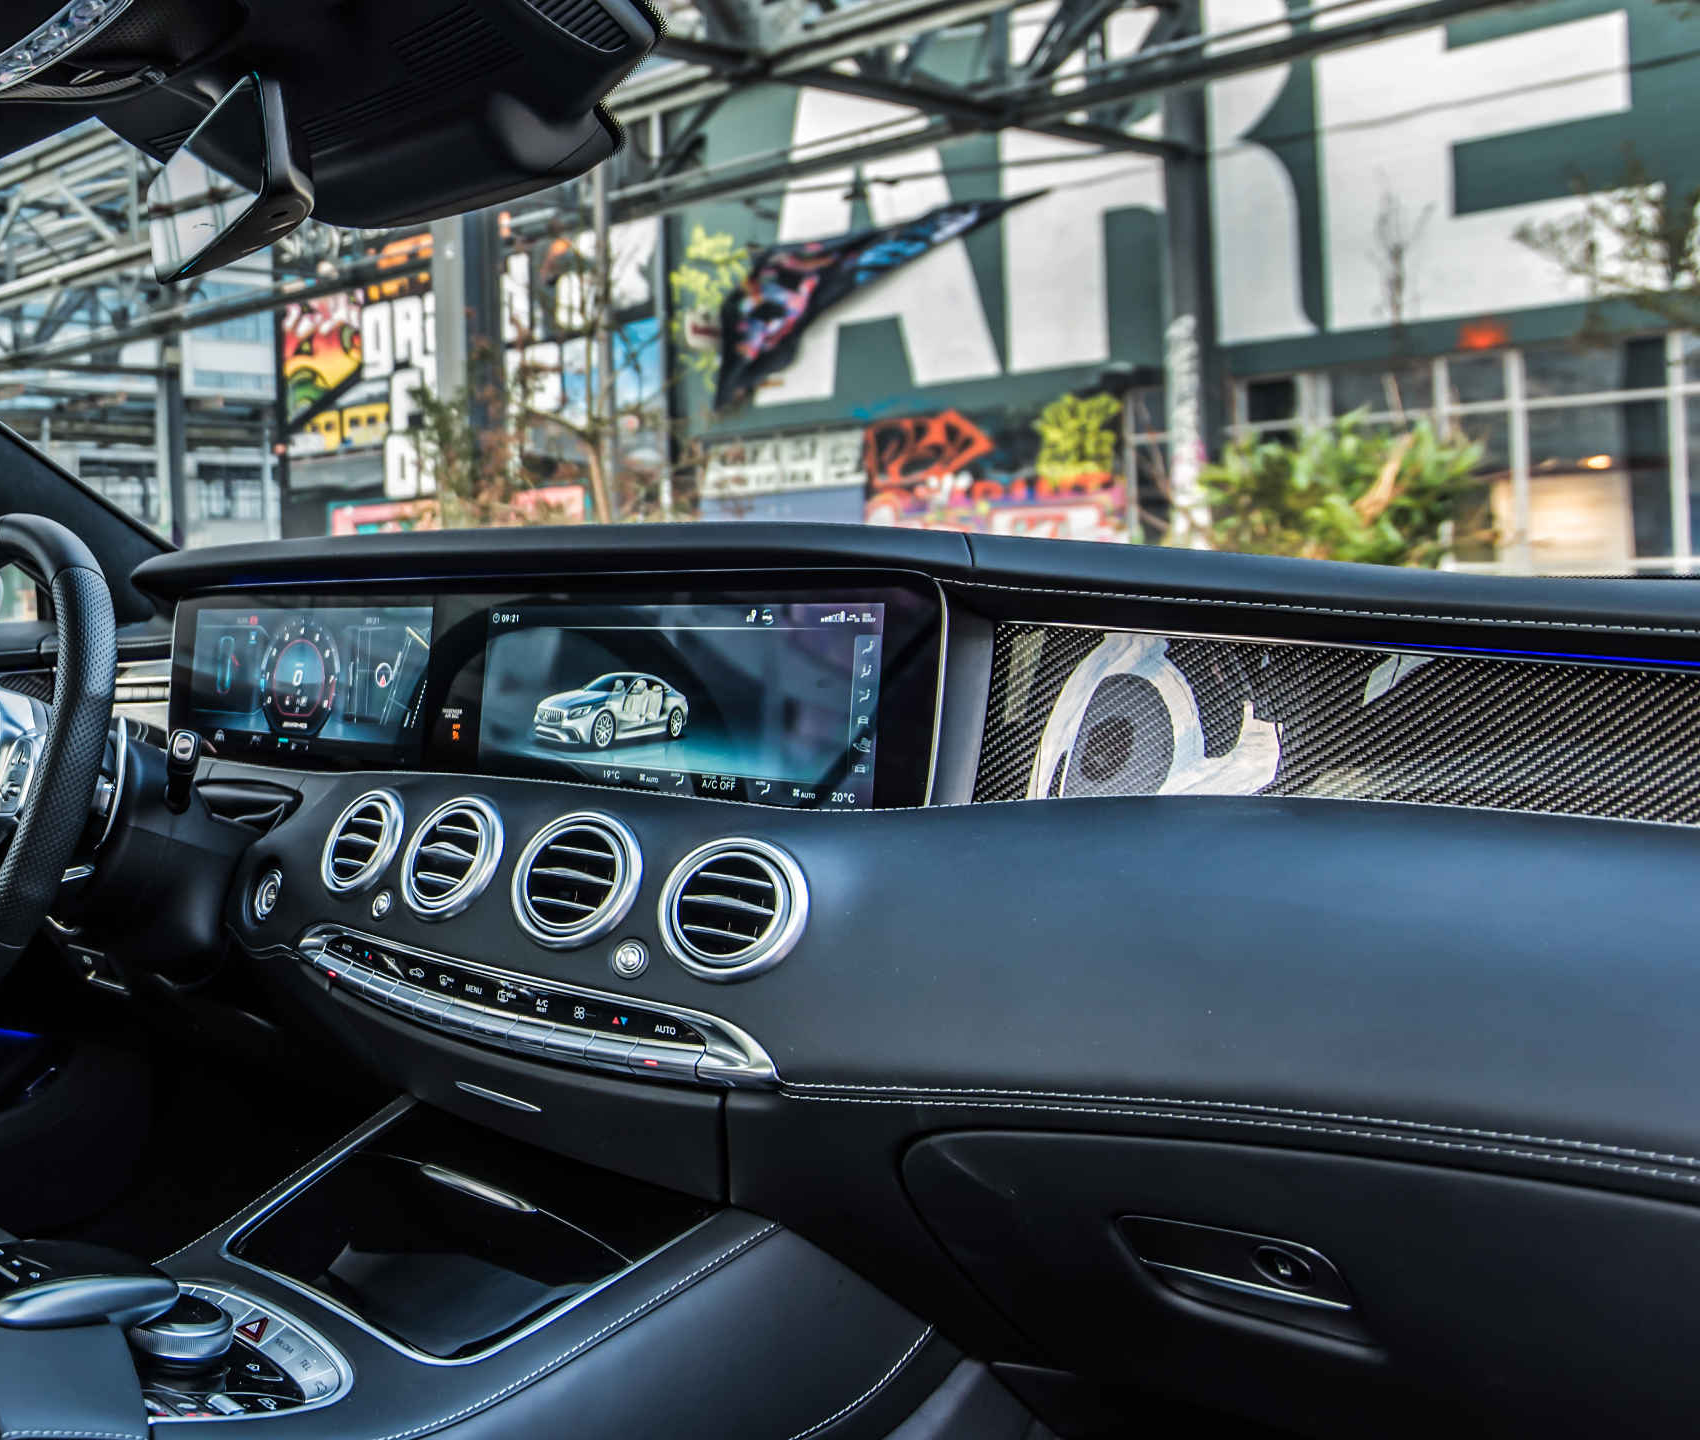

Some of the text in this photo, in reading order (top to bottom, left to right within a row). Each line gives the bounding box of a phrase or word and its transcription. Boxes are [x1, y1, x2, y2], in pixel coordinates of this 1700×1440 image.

[501, 613, 520, 624] 09:21
[701, 779, 736, 792] A/C OFF
[800, 792, 816, 800] AUTO
[831, 791, 855, 804] 20°C
[465, 983, 483, 995] MENU
[536, 999, 549, 1008] A/C
[654, 1023, 677, 1037] AUTO
